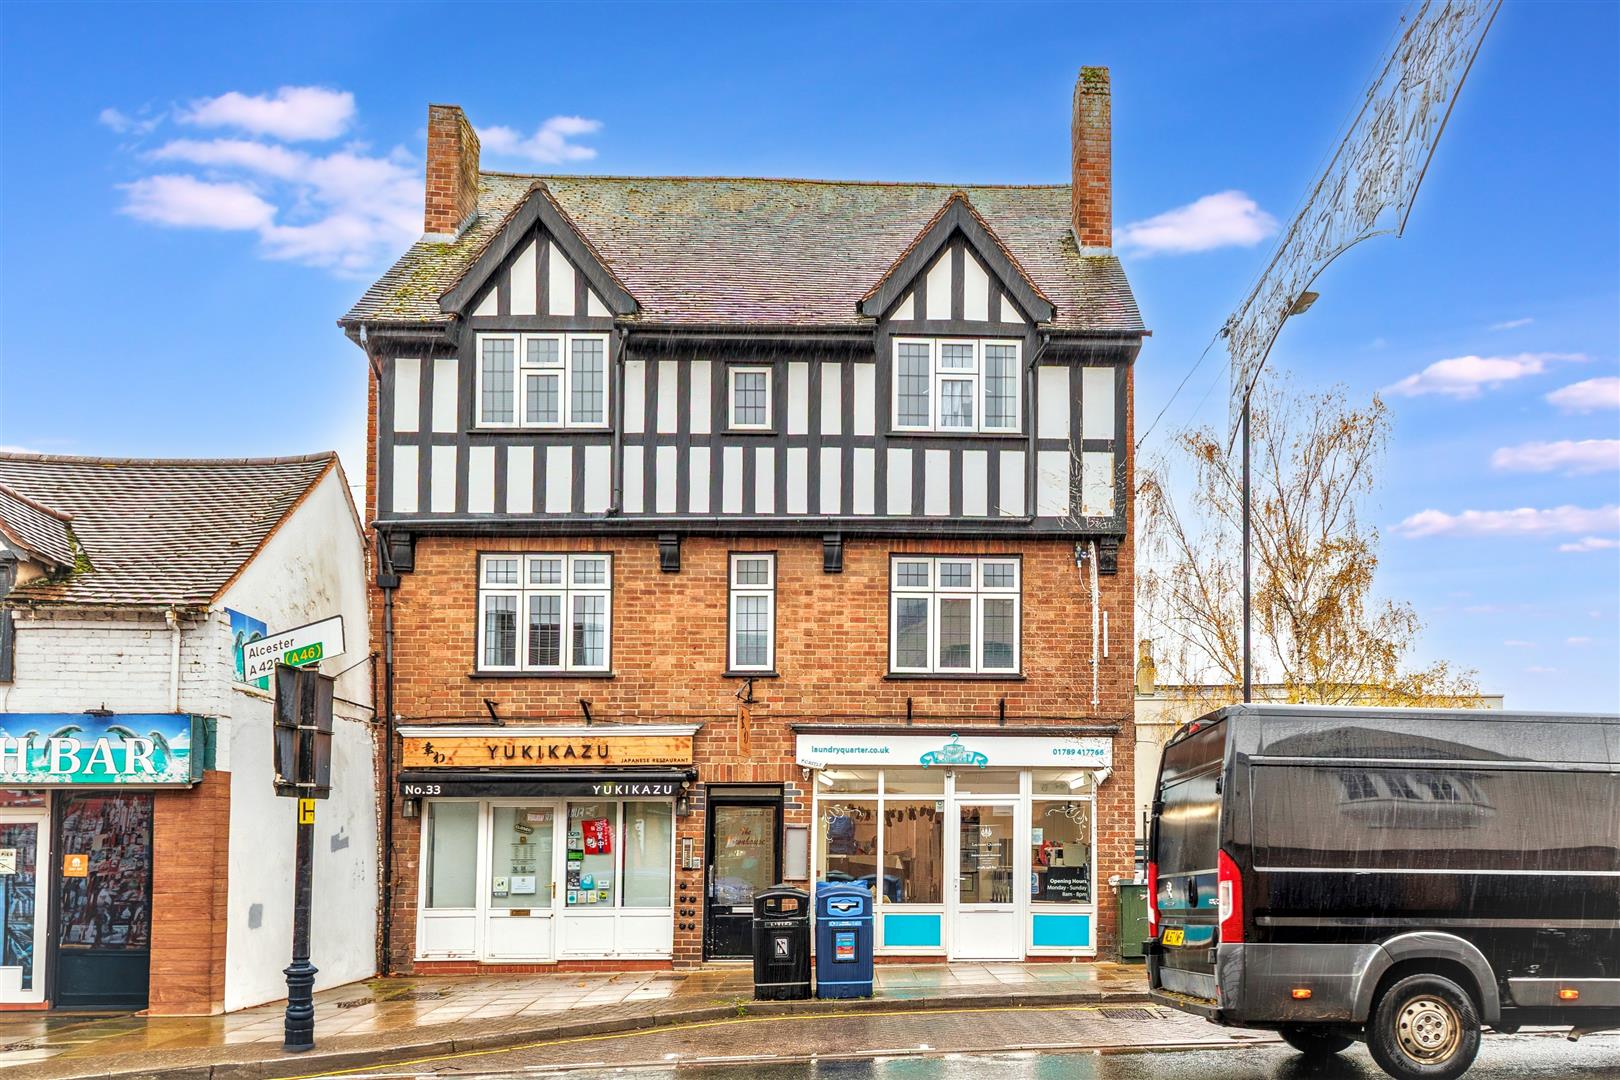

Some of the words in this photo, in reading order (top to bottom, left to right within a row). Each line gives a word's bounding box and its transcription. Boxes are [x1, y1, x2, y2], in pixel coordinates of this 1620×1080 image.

[249, 639, 295, 659] Alcester
[285, 644, 321, 666] (A46)
[49, 737, 159, 775] BAR
[487, 745, 609, 760] YUKIKAZU
[811, 745, 890, 755] laundryquarter.co.uk
[405, 785, 441, 795] No.33
[593, 785, 672, 795] YUKIKAZU
